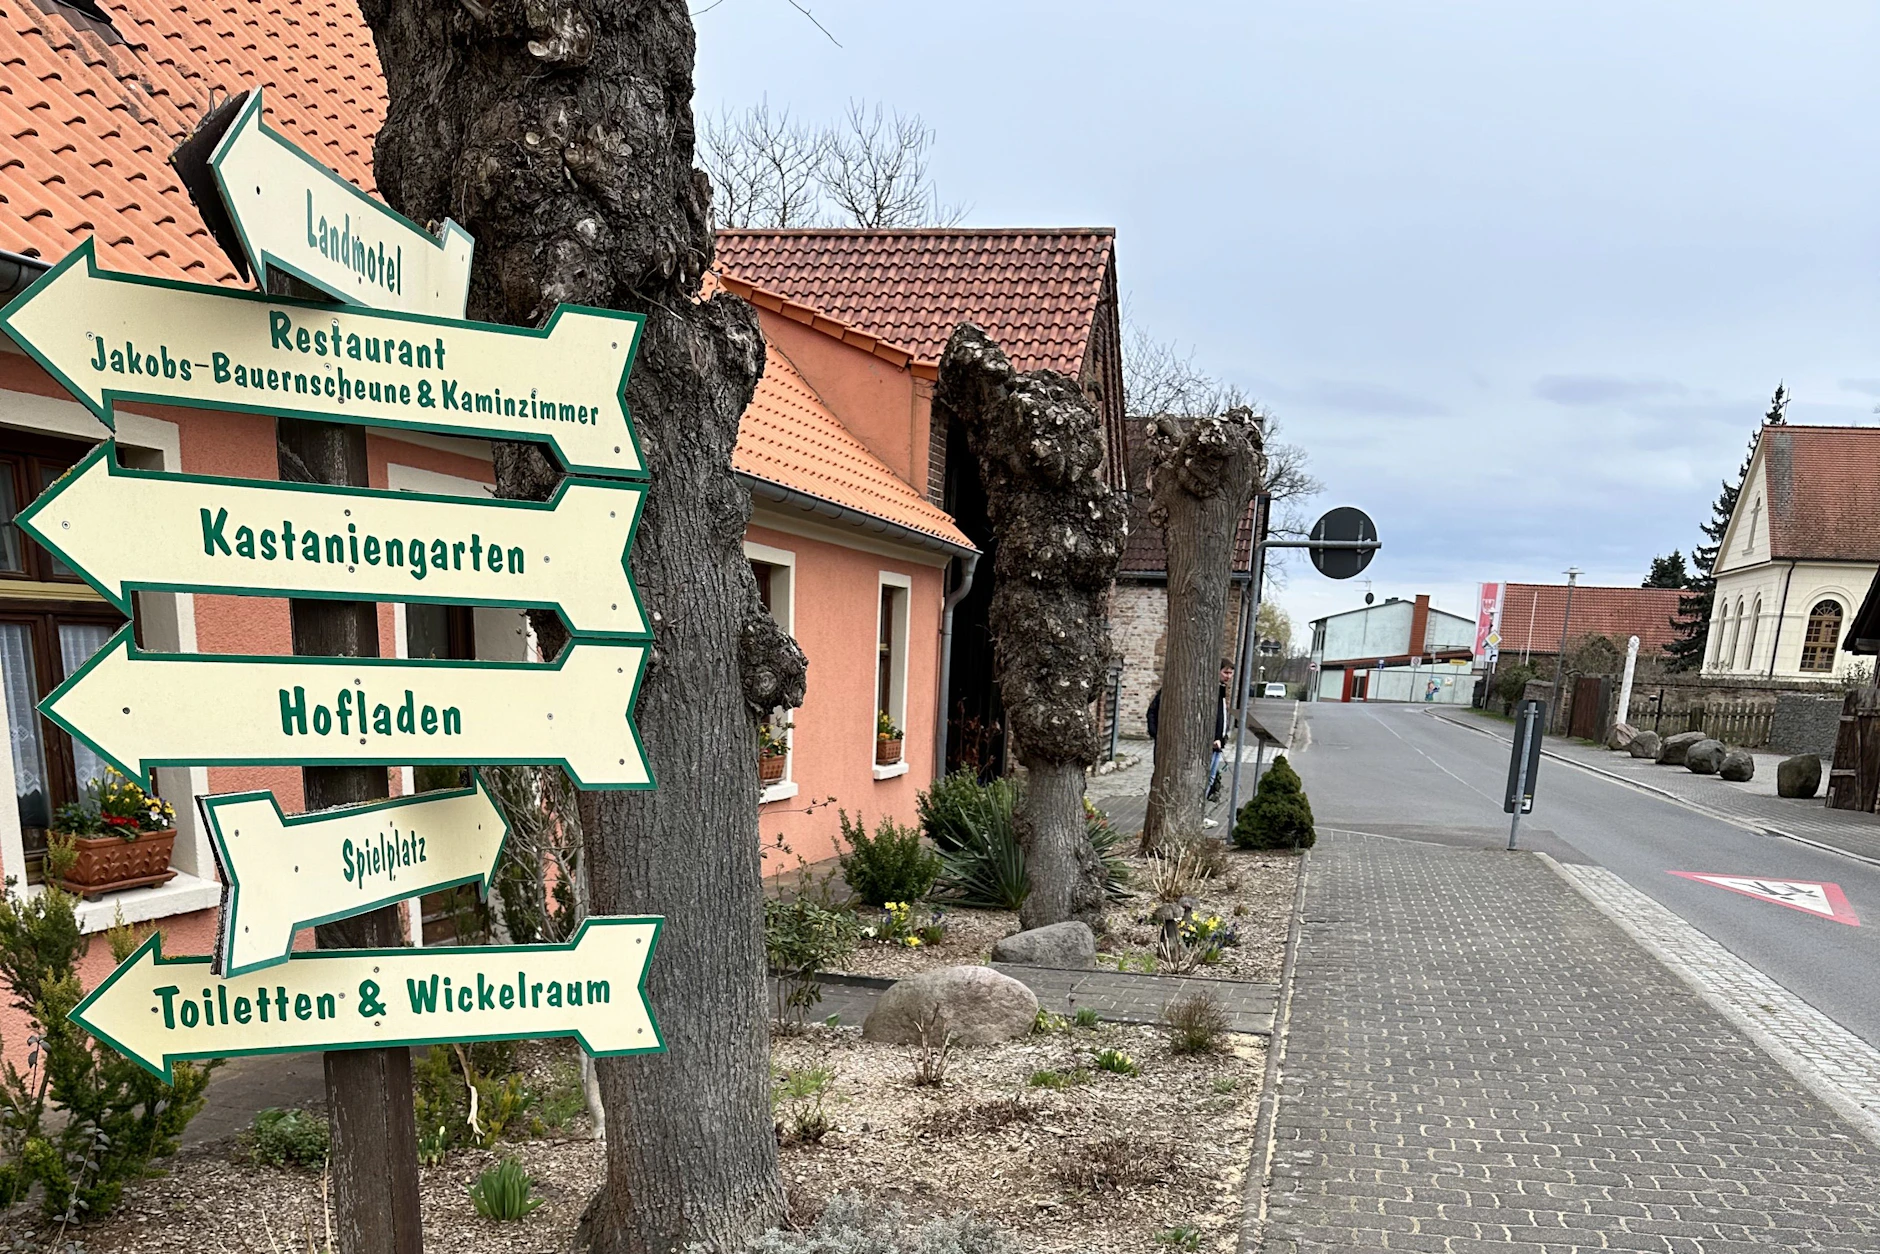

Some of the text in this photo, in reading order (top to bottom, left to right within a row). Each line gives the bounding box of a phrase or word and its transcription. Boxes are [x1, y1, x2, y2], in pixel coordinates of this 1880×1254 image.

[306, 188, 402, 296] Landmotel
[269, 311, 446, 370] Restaurant
[90, 336, 600, 426] Jakobs-Bauernscheune & Kaminzimmer
[200, 508, 526, 580] Kastaniengarten
[279, 686, 463, 736] Hofladen
[342, 835, 427, 888] Spielplatz
[153, 974, 611, 1031] Toiletten & Wickelraum
